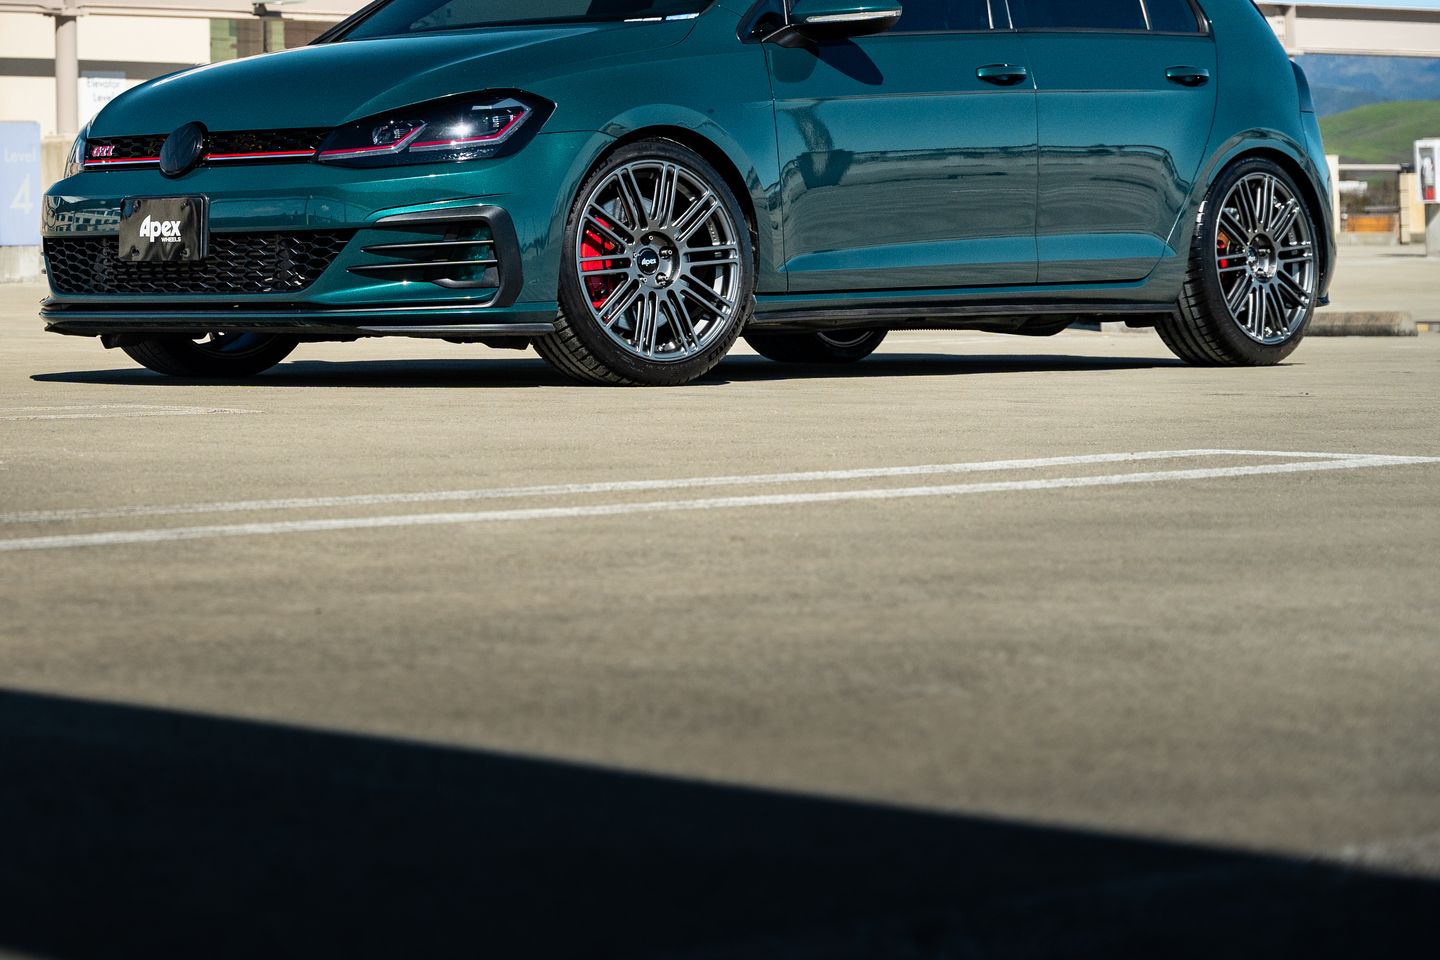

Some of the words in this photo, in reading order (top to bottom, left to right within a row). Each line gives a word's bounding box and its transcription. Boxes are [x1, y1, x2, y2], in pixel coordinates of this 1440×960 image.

[4, 146, 36, 161] Level
[92, 145, 115, 157] GTI
[9, 172, 35, 215] 4
[139, 214, 181, 243] Apex
